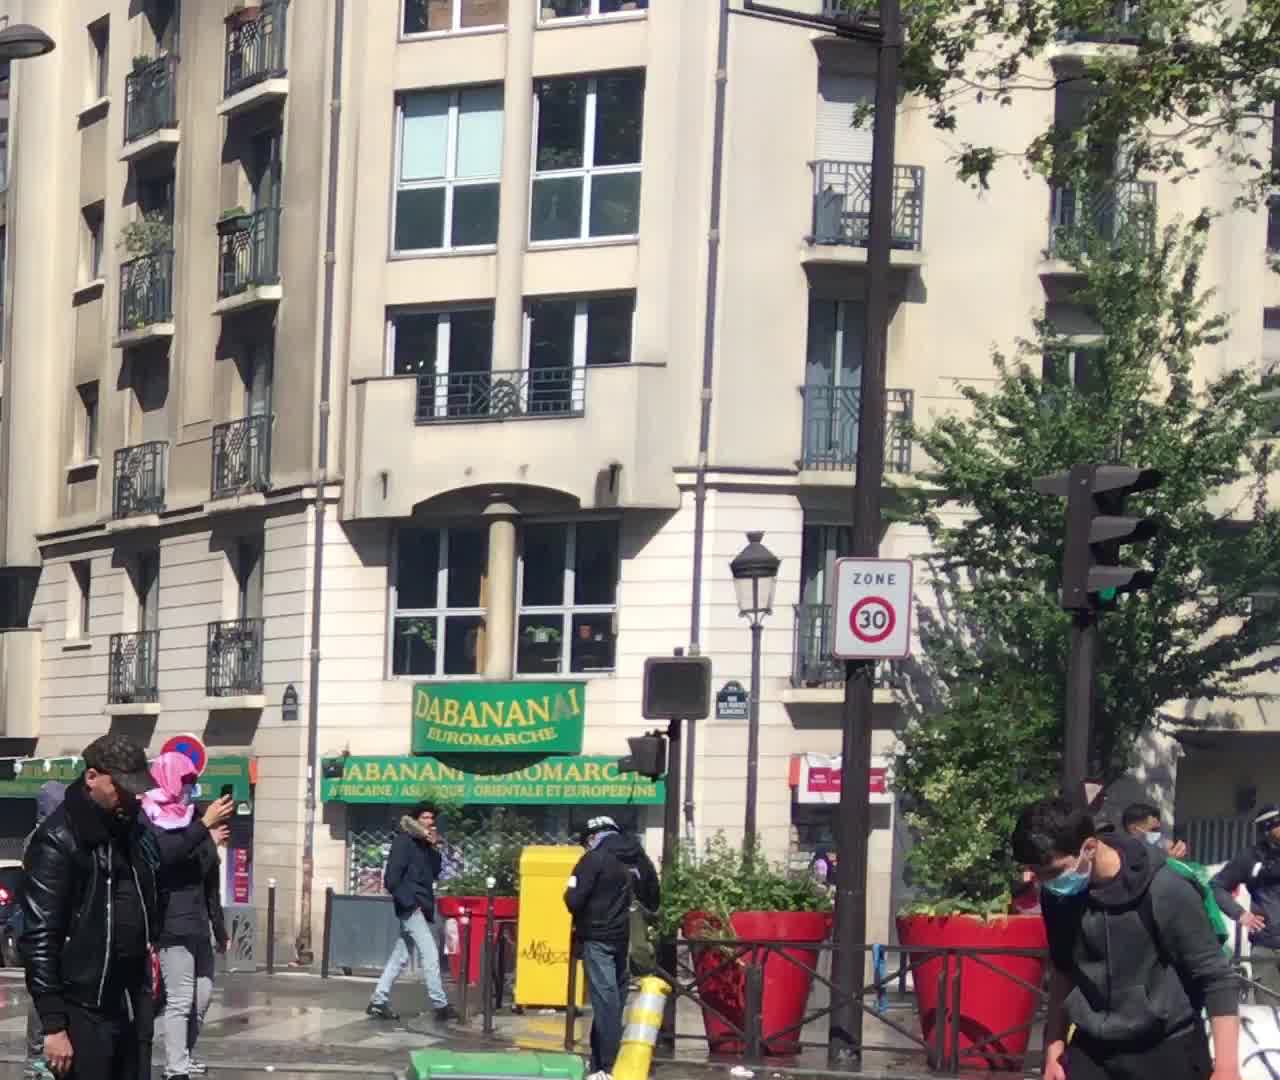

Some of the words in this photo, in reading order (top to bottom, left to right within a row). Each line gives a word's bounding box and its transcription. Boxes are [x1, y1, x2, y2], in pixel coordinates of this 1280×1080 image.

[853, 572, 897, 586] ZONE
[859, 609, 887, 630] 30
[426, 725, 559, 746] EUROMARCHE
[328, 783, 393, 797] AFRICAINE
[473, 783, 543, 797] ORIENTALE
[546, 783, 562, 797] ET
